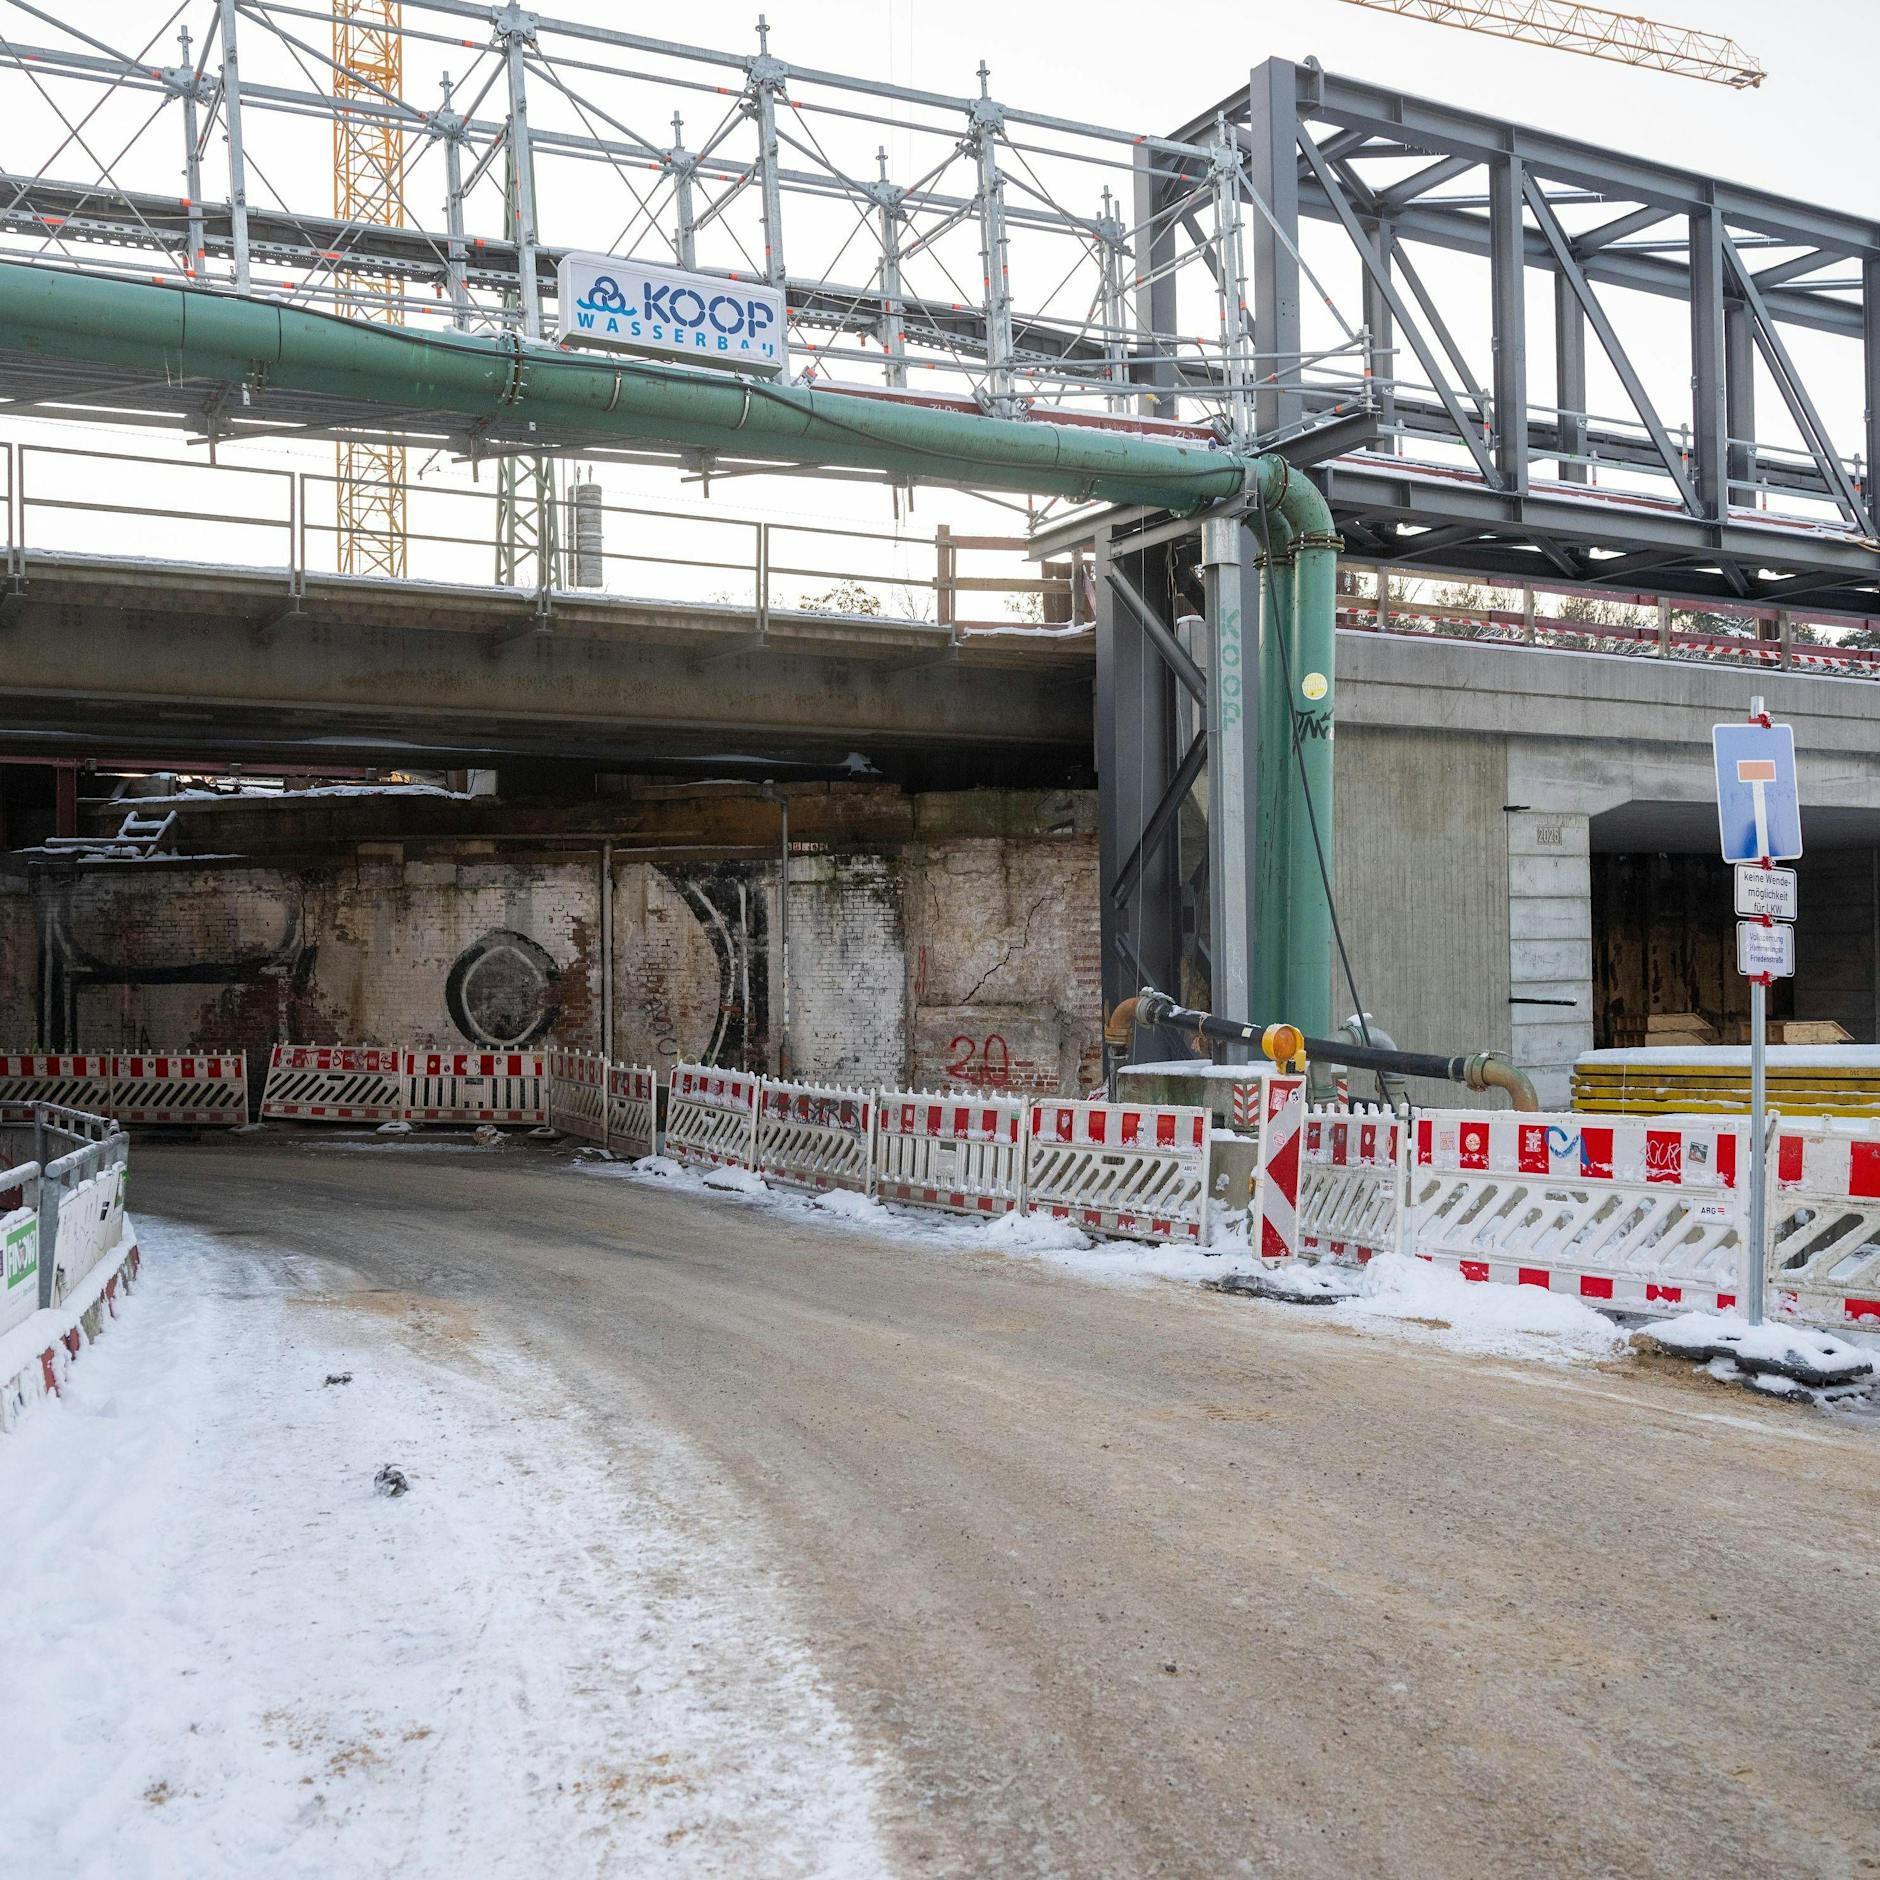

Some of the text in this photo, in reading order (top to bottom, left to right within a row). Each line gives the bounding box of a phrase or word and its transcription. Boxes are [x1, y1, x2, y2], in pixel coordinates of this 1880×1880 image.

[643, 281, 774, 338] KOOP
[1220, 607, 1241, 731] KOOP
[1744, 872, 1791, 887] keine Wende-
[1748, 887, 1788, 901] möglichkeit
[1754, 902, 1783, 915] für LKW
[1700, 1206, 1717, 1215] ARG
